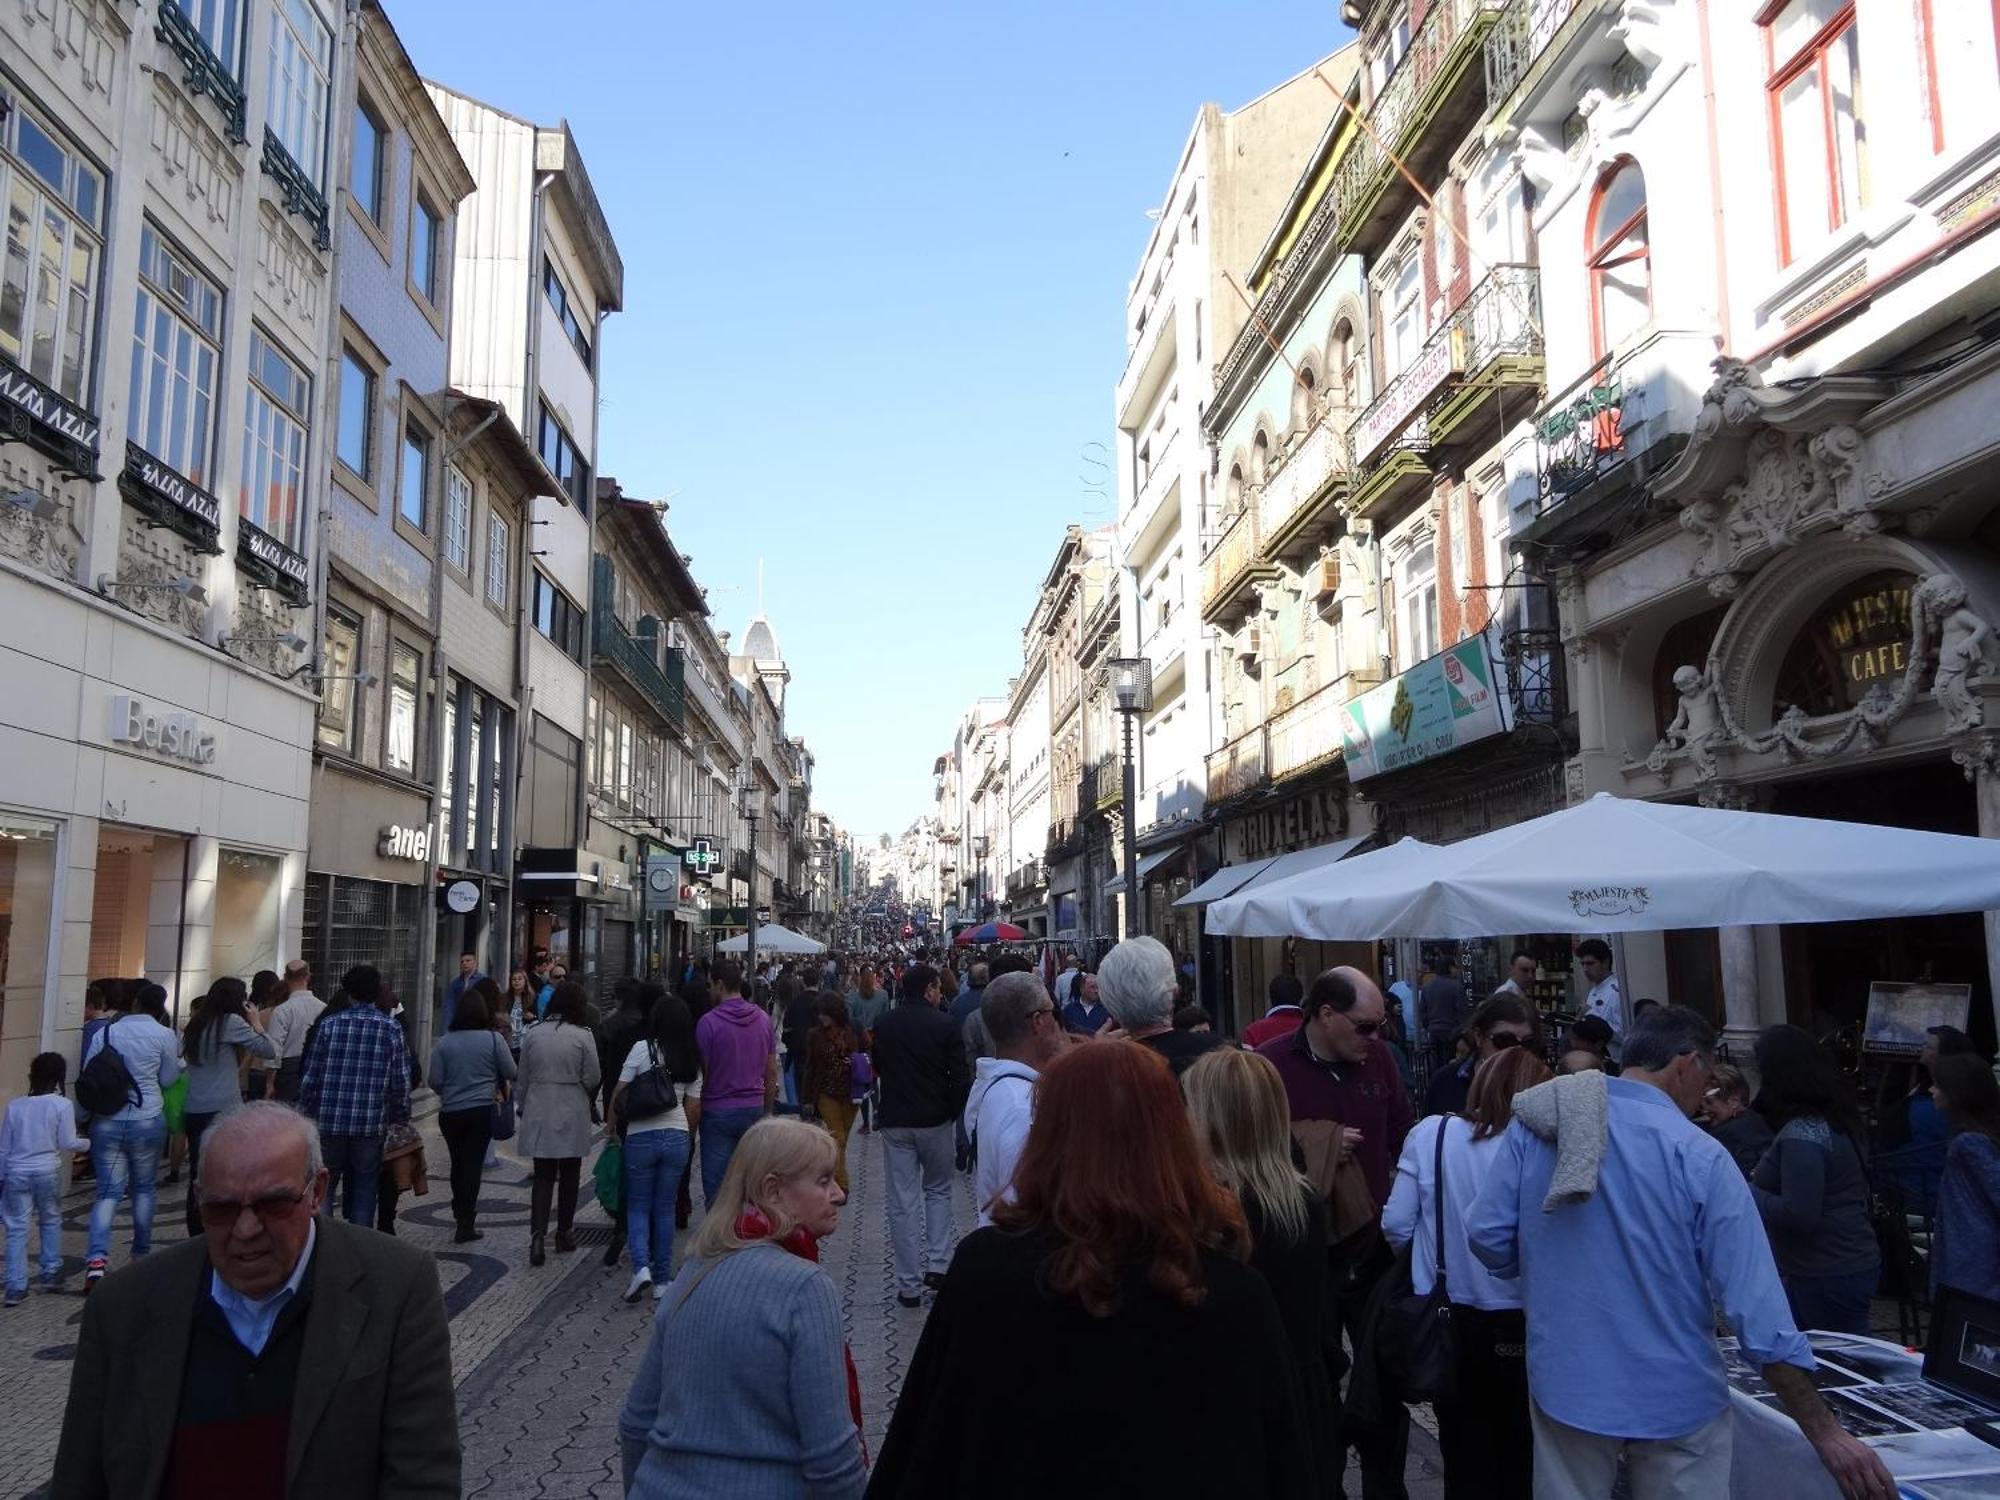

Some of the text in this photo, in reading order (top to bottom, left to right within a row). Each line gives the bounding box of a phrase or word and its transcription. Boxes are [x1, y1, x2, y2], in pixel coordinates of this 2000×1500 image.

[1369, 396, 1397, 432] PARTIDO
[1402, 344, 1448, 400] SOCIALISTA
[114, 696, 215, 764] Bershka
[387, 823, 433, 862] anel
[1238, 788, 1343, 857] BRUXELAS
